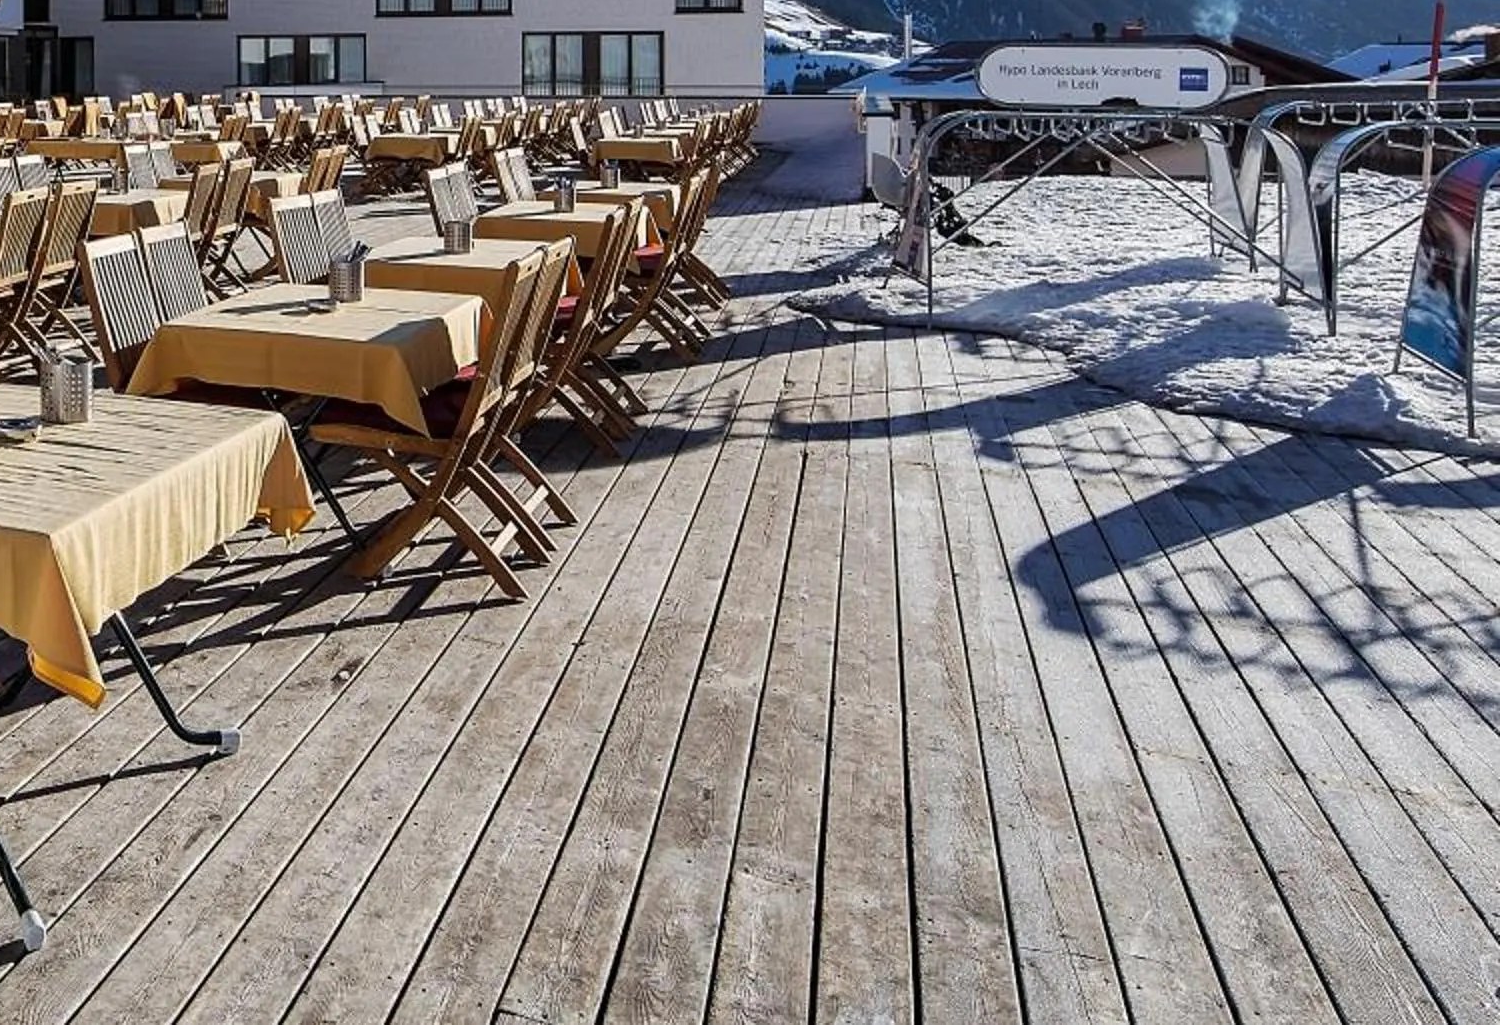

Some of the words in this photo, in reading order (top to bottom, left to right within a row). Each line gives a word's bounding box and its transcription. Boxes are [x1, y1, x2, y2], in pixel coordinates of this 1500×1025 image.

[1031, 63, 1099, 76] Landesbank
[1057, 78, 1069, 89] in
[1071, 78, 1099, 90] Lech
